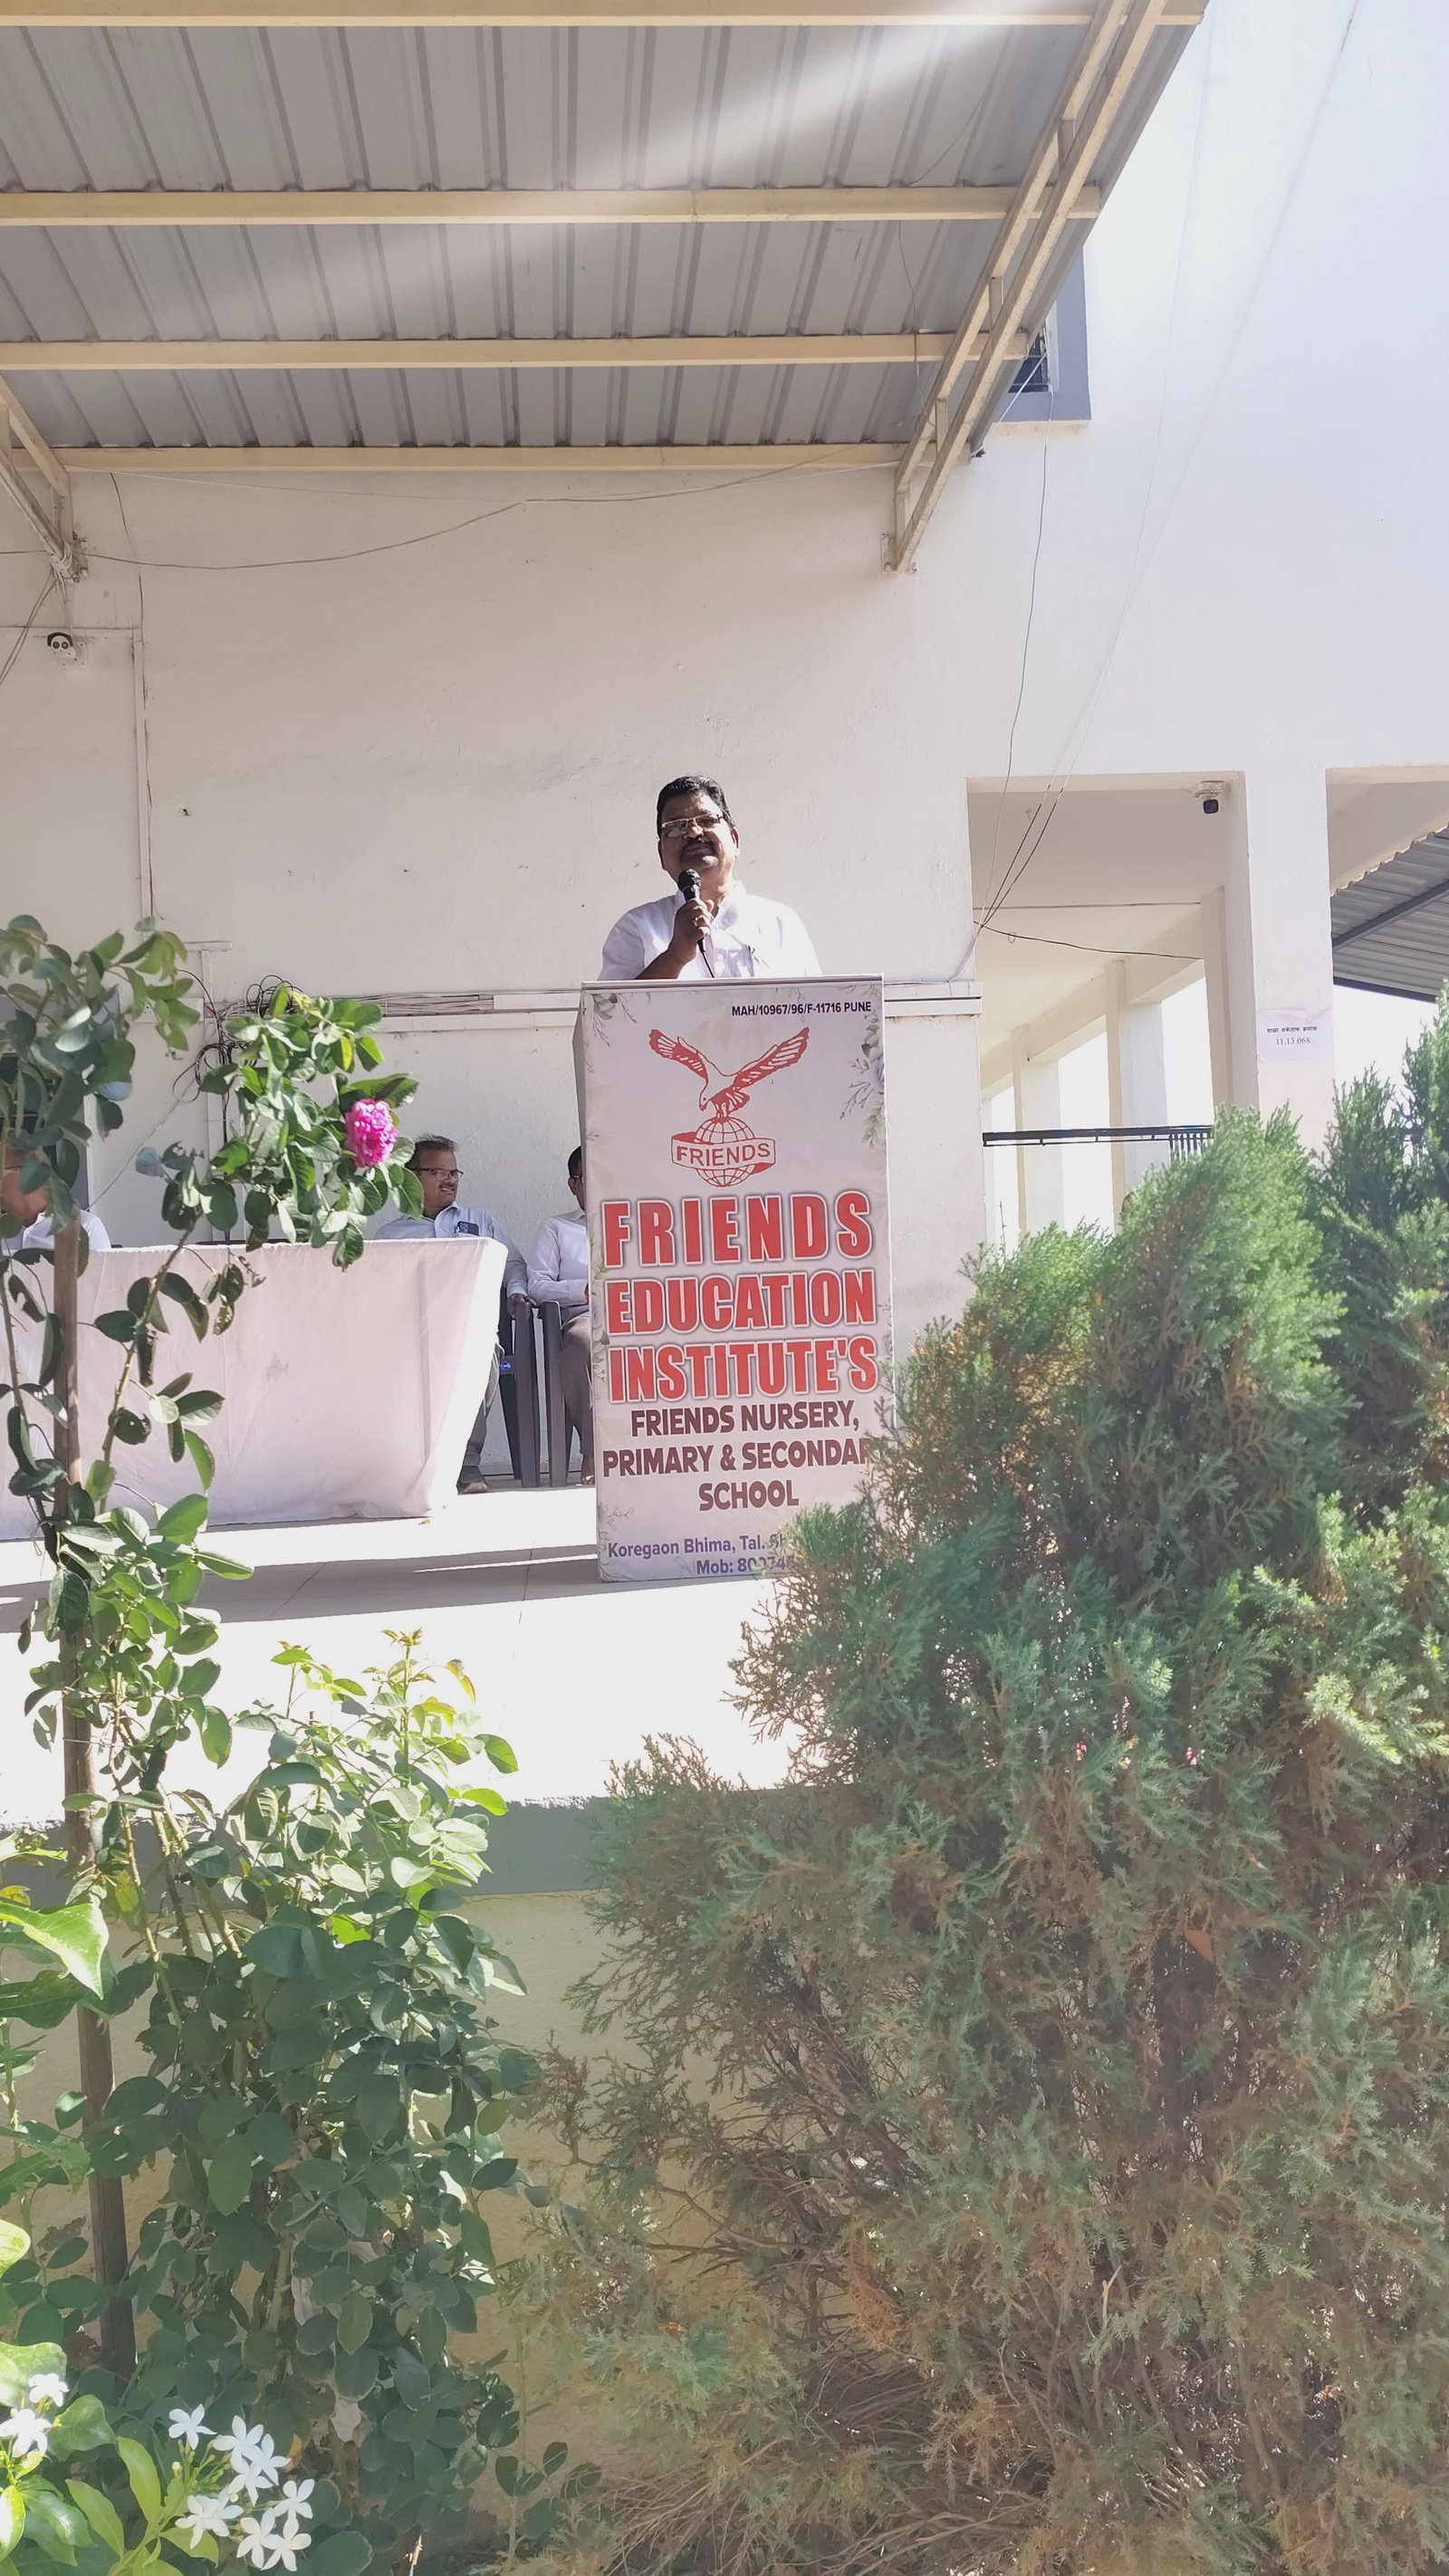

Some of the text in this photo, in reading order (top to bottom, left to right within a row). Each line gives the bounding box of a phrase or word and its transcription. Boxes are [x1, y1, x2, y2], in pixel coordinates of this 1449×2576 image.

[732, 1001, 872, 1016] MAH/10967/96/F-11716 PUNE
[676, 1141, 772, 1168] FRIENDS
[601, 1190, 872, 1268] FRIENDS
[605, 1269, 878, 1335] EDUCATION
[608, 1336, 878, 1404] INSTITUTE'S
[631, 1399, 859, 1437] FRIENDS NURSERY,
[602, 1437, 877, 1477] PRIMARY & SECONDAR
[698, 1479, 800, 1511] SCHOOL
[608, 1540, 679, 1559] Koregaon
[684, 1536, 735, 1554] Bhima,
[739, 1534, 765, 1551] Tal.
[696, 1559, 734, 1575] Mob:
